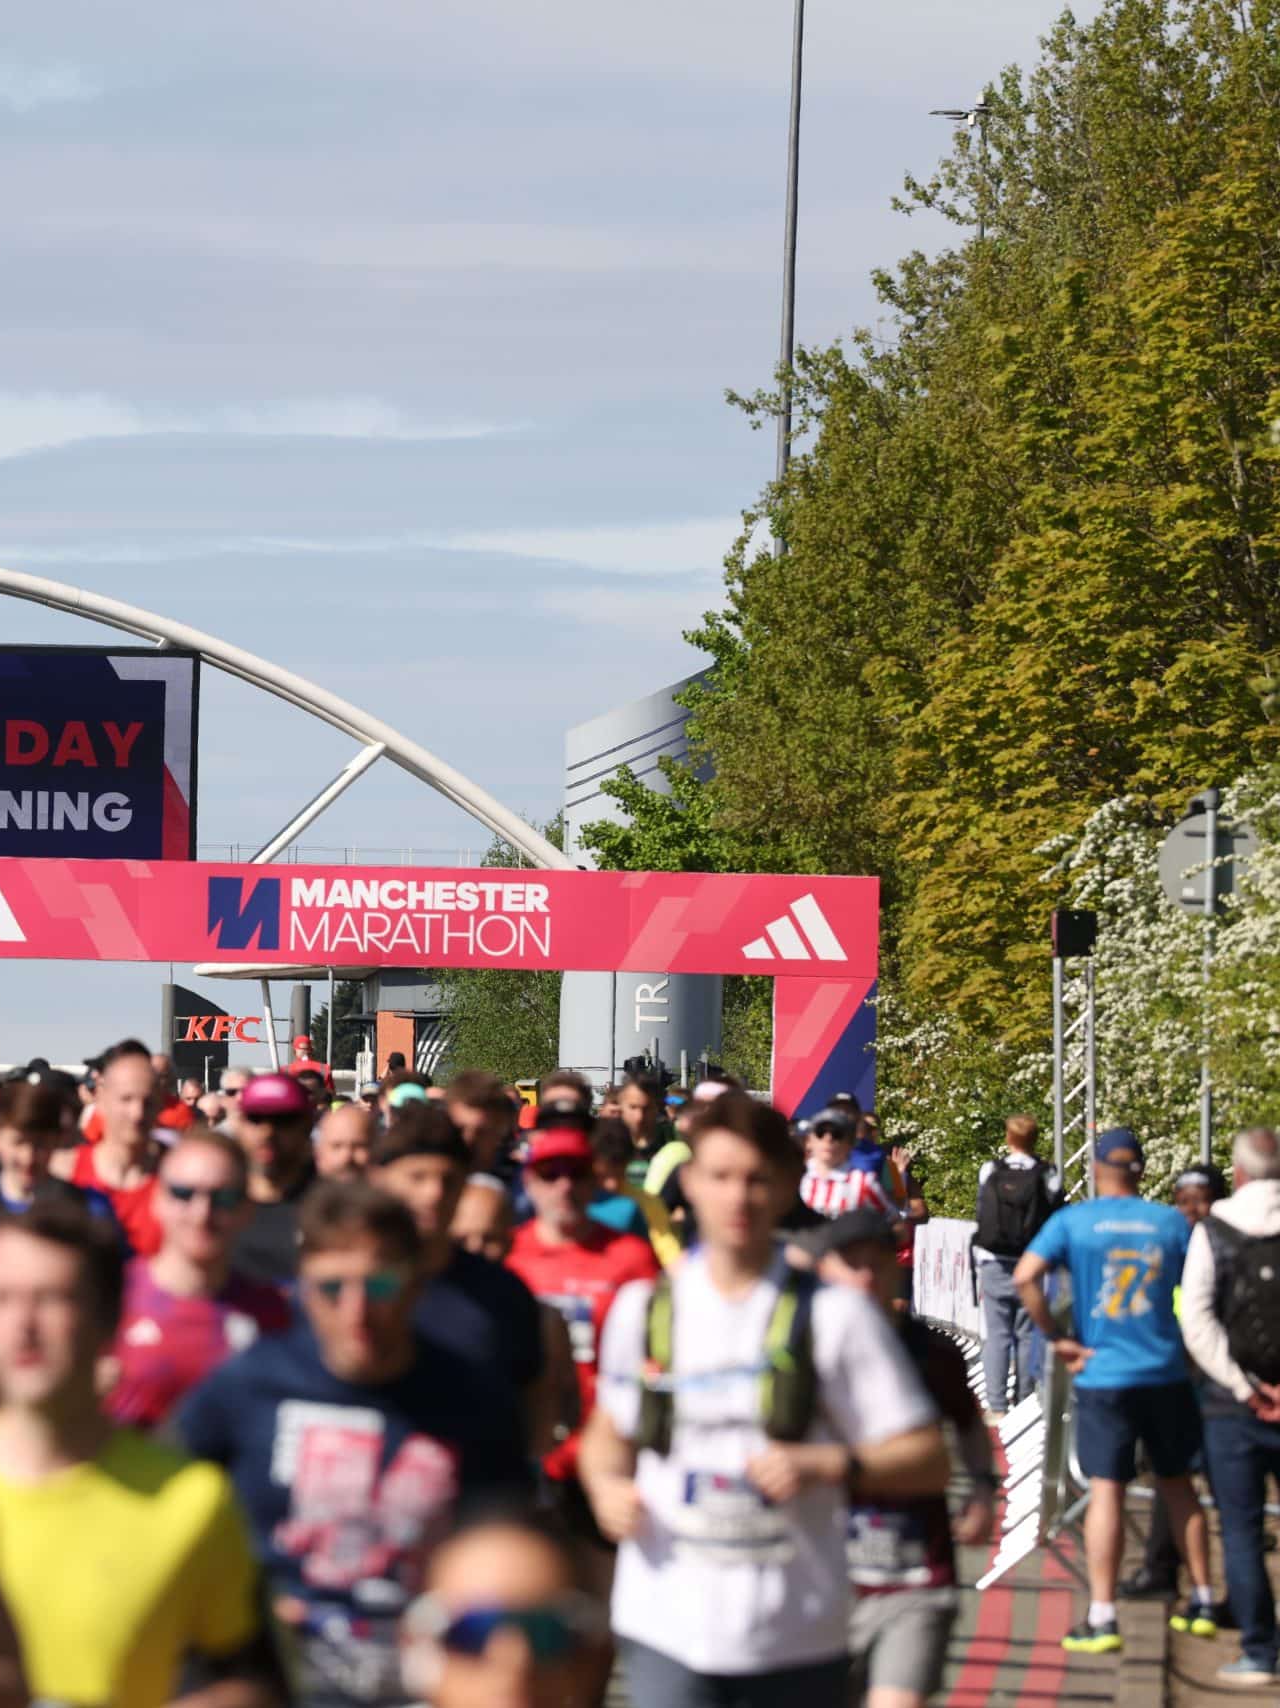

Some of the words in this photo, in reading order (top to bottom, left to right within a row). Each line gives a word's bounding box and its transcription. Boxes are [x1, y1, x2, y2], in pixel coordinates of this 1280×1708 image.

[5, 719, 145, 768] DAY
[291, 878, 550, 913] MANCHESTER
[289, 912, 551, 957] MARATHON
[184, 1015, 262, 1043] KFC
